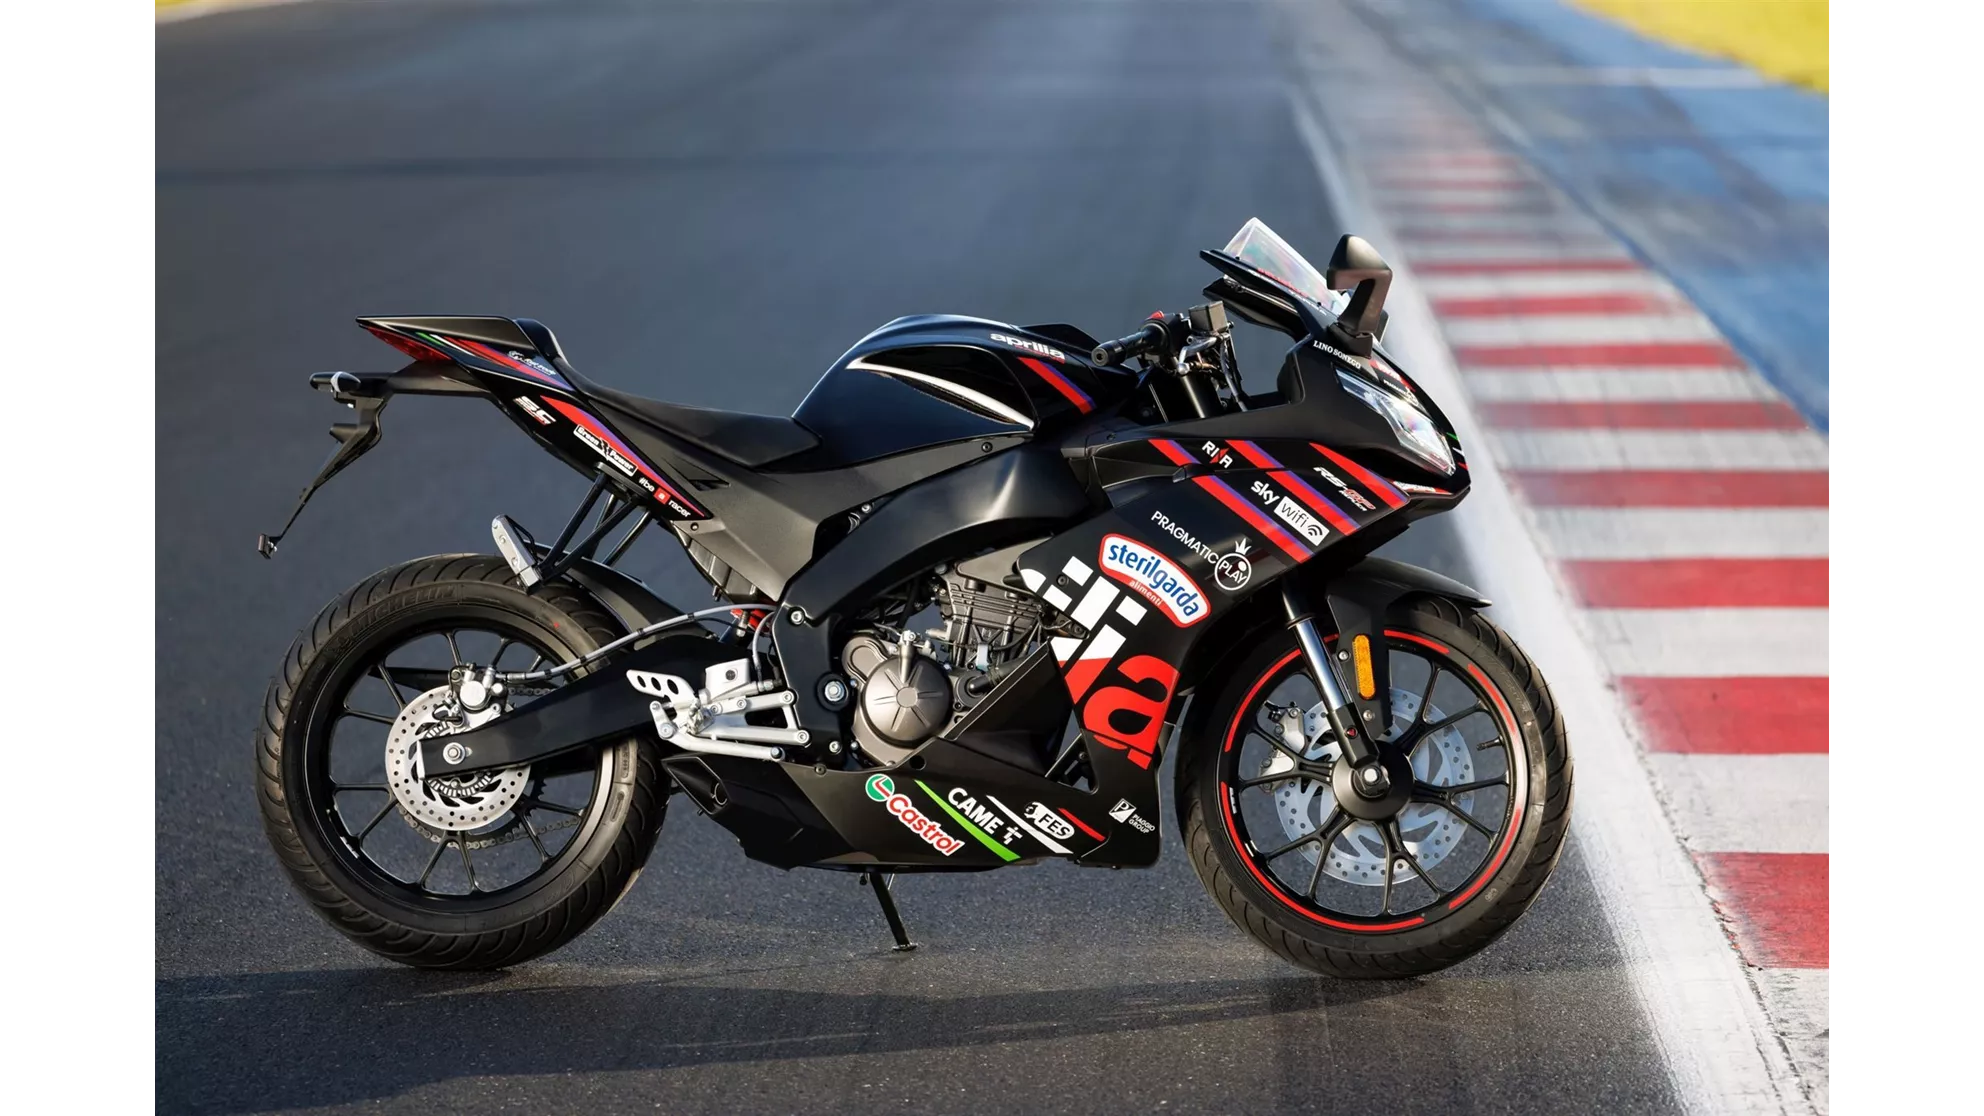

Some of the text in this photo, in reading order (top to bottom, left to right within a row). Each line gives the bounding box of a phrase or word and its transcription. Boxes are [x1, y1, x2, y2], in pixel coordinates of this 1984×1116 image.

[990, 333, 1065, 361] aprilia
[1313, 340, 1361, 369] LINO SONEGO
[578, 426, 634, 470] Green Power
[668, 500, 691, 517] racer
[1250, 481, 1309, 528] sky wifi
[1151, 511, 1248, 584] PRAGMATIC PLAY
[1108, 544, 1199, 617] sterilgarda
[1128, 580, 1163, 607] alimenti
[887, 794, 963, 856] Castrol
[948, 787, 1003, 835] CAME
[1038, 813, 1070, 837] FES
[1129, 818, 1149, 833] GROUP
[1132, 813, 1155, 831] PIAGGIO
